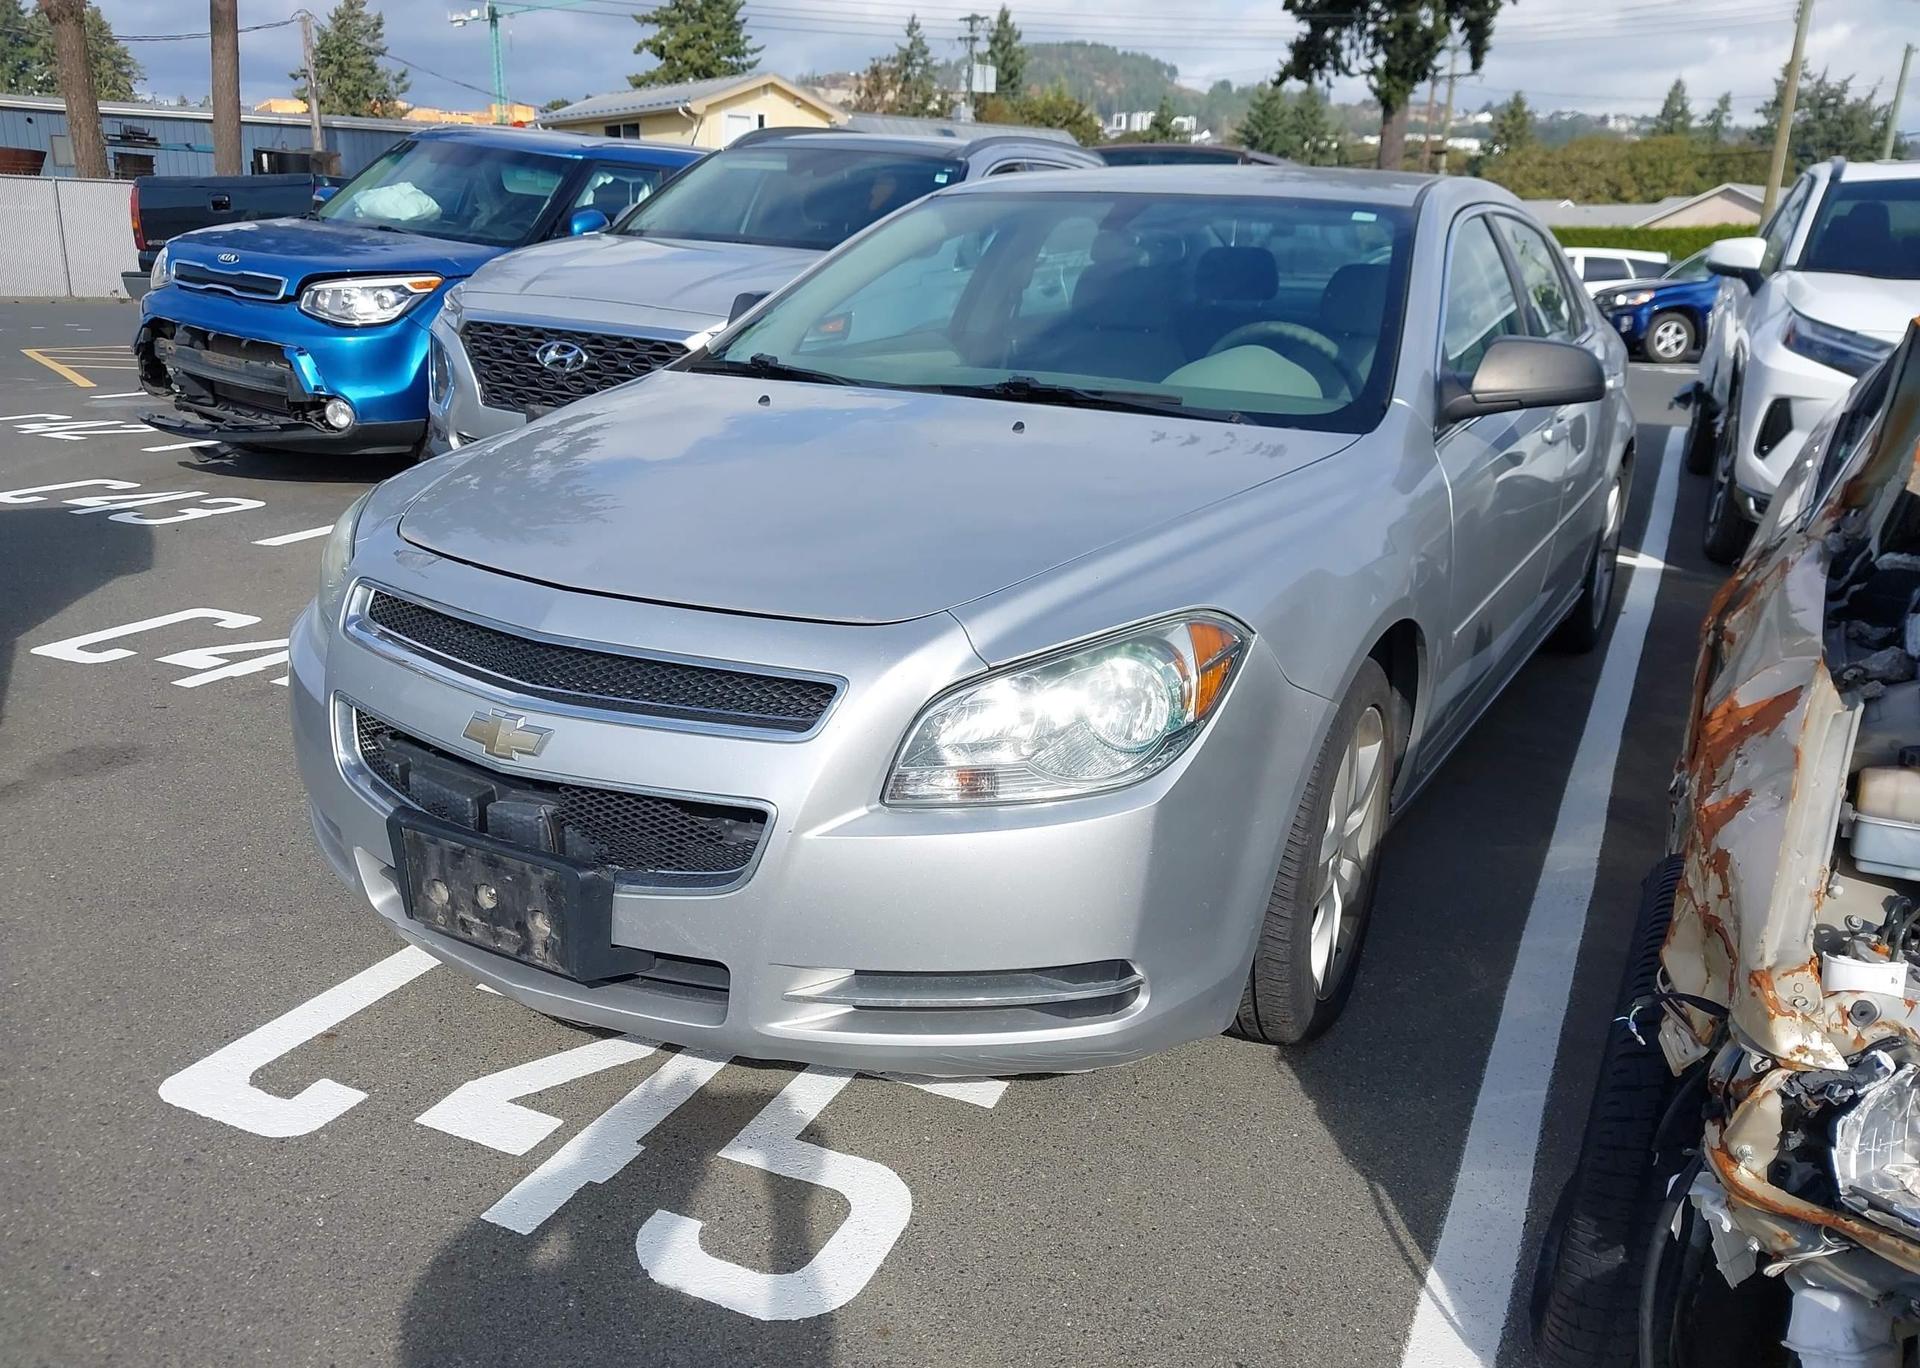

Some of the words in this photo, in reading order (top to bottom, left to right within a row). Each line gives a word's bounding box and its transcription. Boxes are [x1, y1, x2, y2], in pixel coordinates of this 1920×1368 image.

[219, 253, 237, 262] KIA
[0, 479, 267, 525] C43
[30, 607, 290, 689] C4
